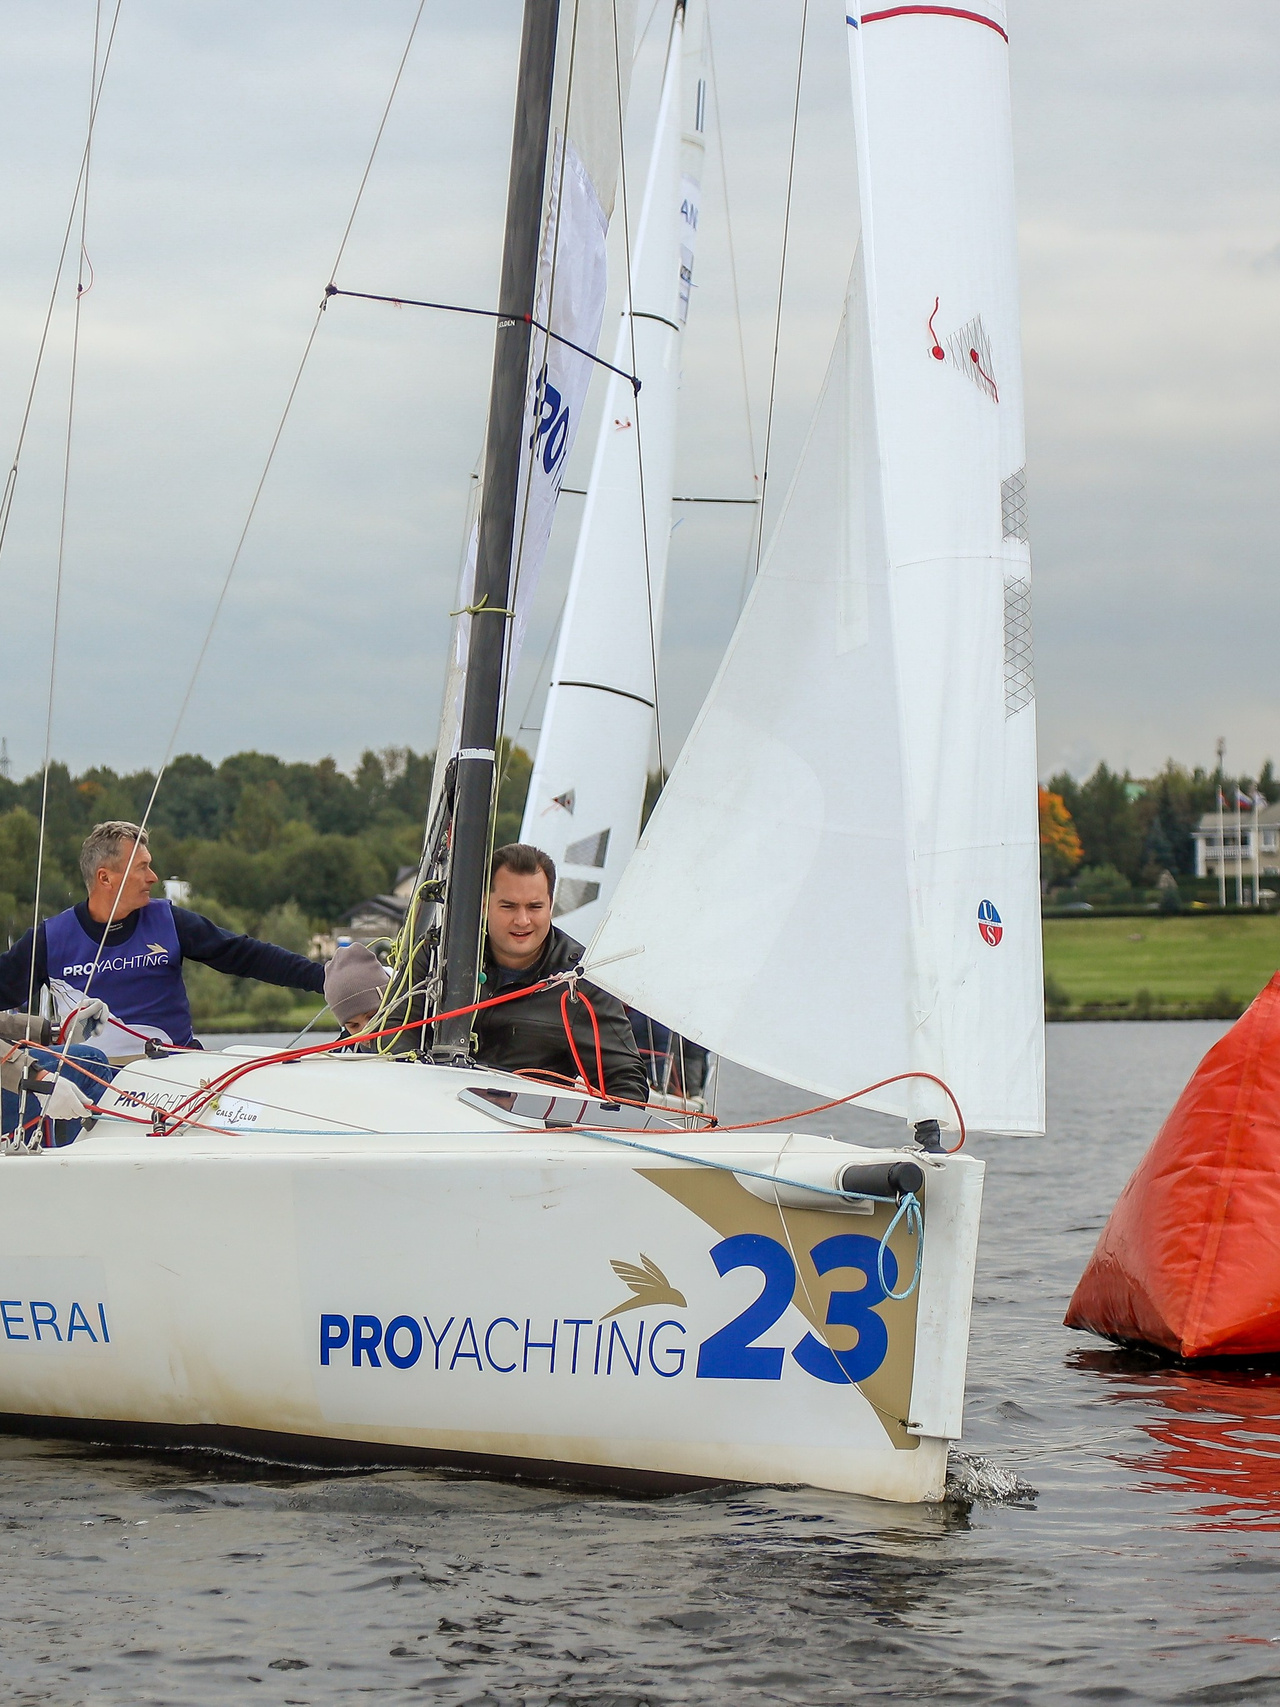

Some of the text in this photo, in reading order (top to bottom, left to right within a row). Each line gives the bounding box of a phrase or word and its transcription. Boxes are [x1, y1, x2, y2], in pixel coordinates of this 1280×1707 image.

[63, 954, 169, 976] PROYACHTING
[114, 1091, 207, 1114] PROYACHTING
[239, 1113, 257, 1122] CLUB
[320, 1233, 899, 1385] PROYACHTING 23
